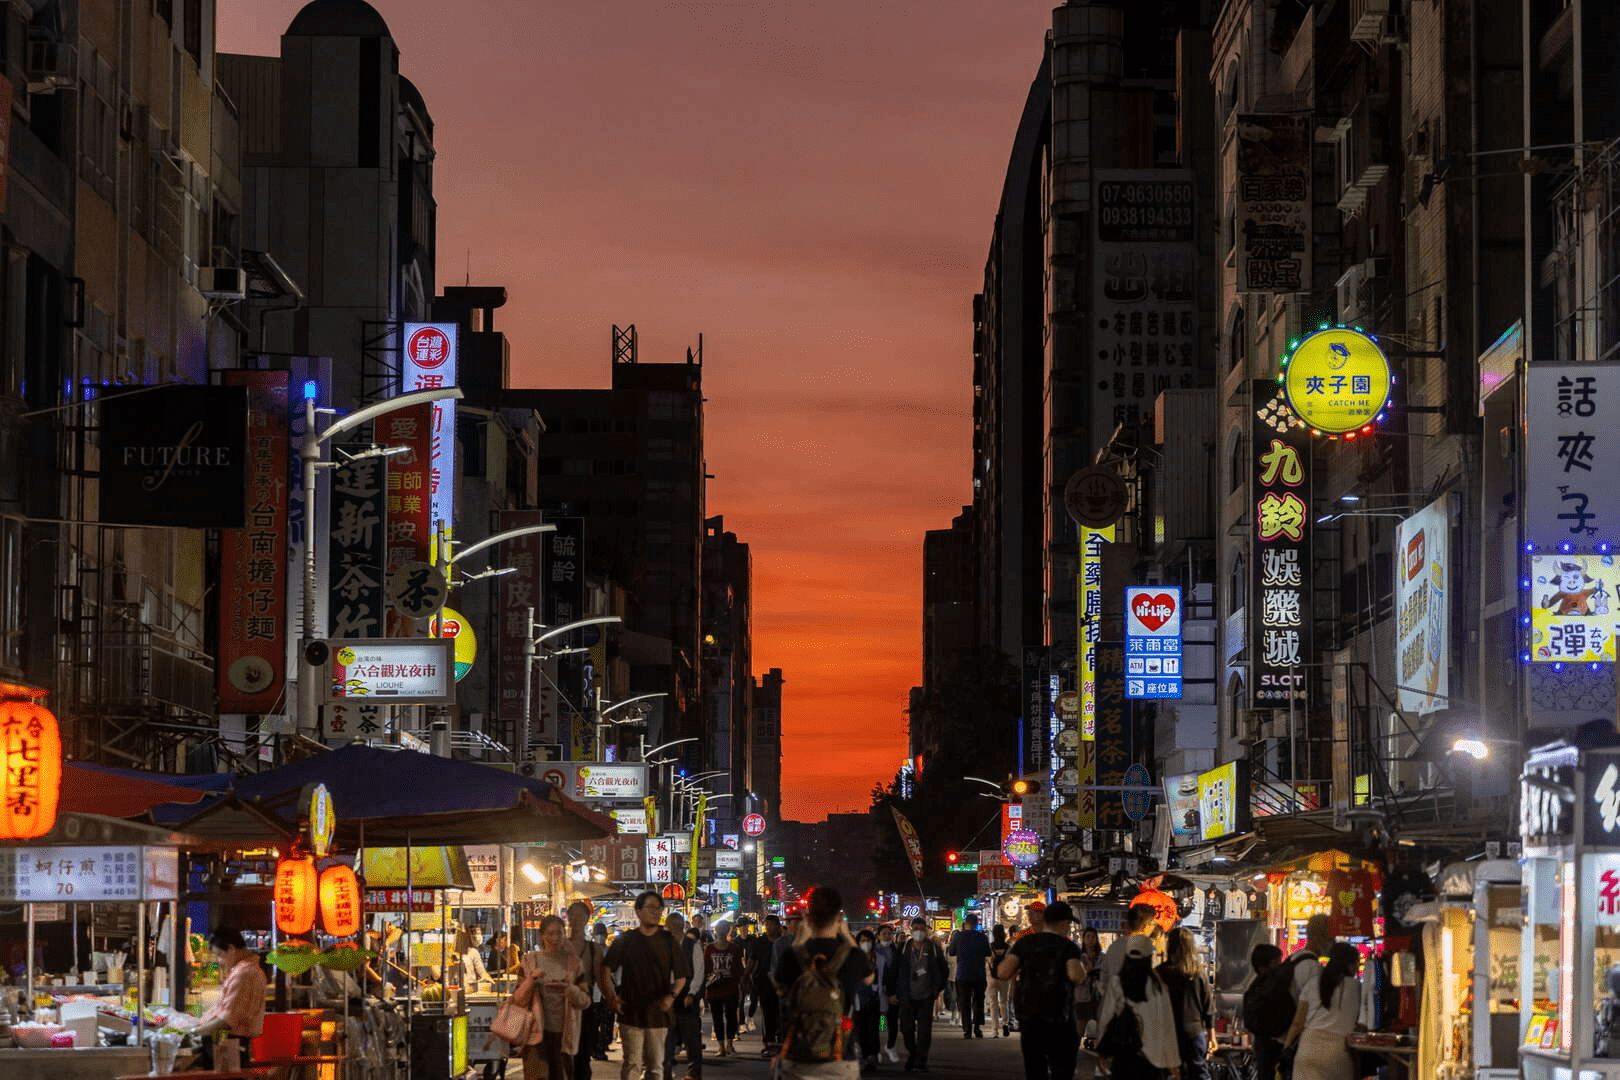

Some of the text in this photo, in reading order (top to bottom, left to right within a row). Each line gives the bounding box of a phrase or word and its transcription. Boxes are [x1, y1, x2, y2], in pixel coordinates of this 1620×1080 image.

[1305, 375, 1371, 394] 夾子園
[1328, 399, 1371, 407] CATCH ME
[121, 446, 231, 467] FUTURE
[1556, 375, 1598, 536] 話夾子
[1262, 548, 1302, 667] 娛樂城
[1129, 638, 1178, 652] 萊爾富
[1550, 624, 1586, 656] 彈
[353, 664, 437, 678] 六合觀光夜市
[1129, 662, 1144, 670] ATM
[1260, 674, 1304, 686] SLOT
[1147, 683, 1178, 694] 座位區
[3, 716, 44, 738] 六合
[35, 857, 97, 876] 蚵仔煎
[57, 882, 74, 895] 70
